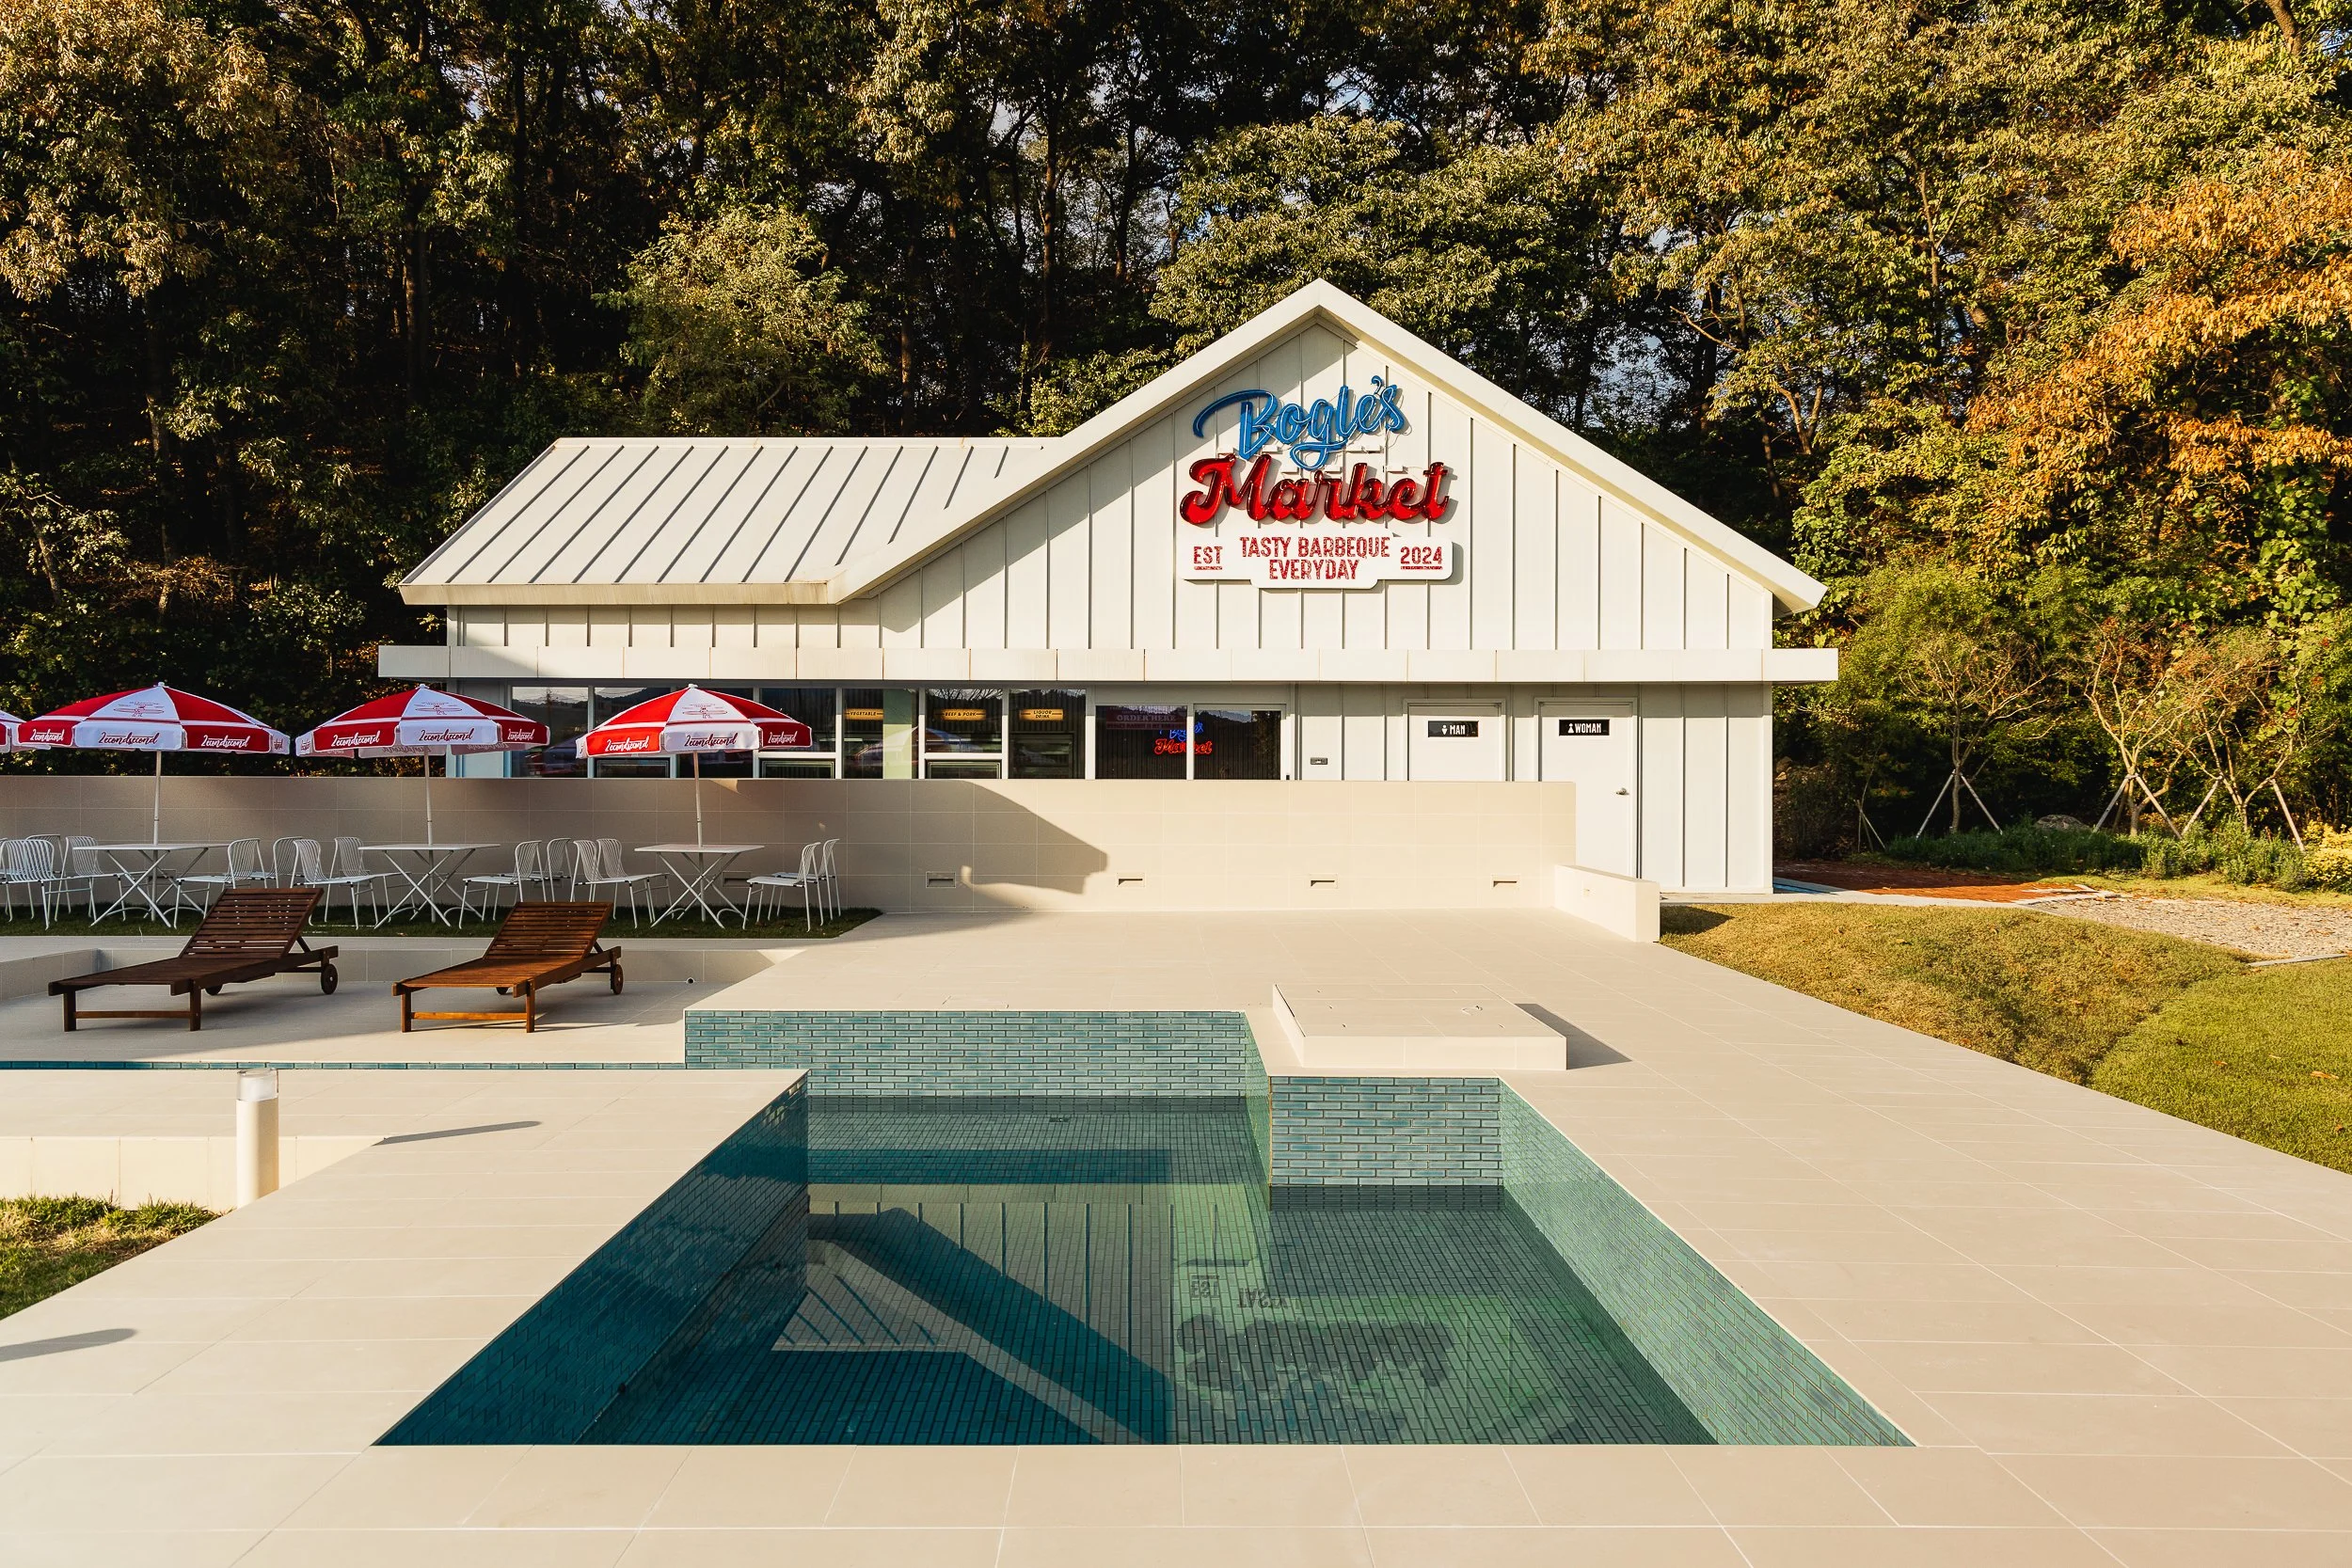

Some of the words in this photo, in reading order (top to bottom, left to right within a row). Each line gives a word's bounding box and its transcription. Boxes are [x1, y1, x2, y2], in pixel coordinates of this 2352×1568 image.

[1192, 375, 1405, 471] Bogle's
[1179, 452, 1450, 525] Market
[1193, 546, 1223, 564] EST
[1239, 536, 1292, 558] TASTY
[1297, 536, 1391, 560] BARBEQUE
[1400, 546, 1443, 564] 2024
[1269, 559, 1360, 579] EVERYDAY
[1450, 724, 1466, 736] MAN
[1574, 722, 1602, 734] WOMAN
[1154, 738, 1212, 754] Maret
